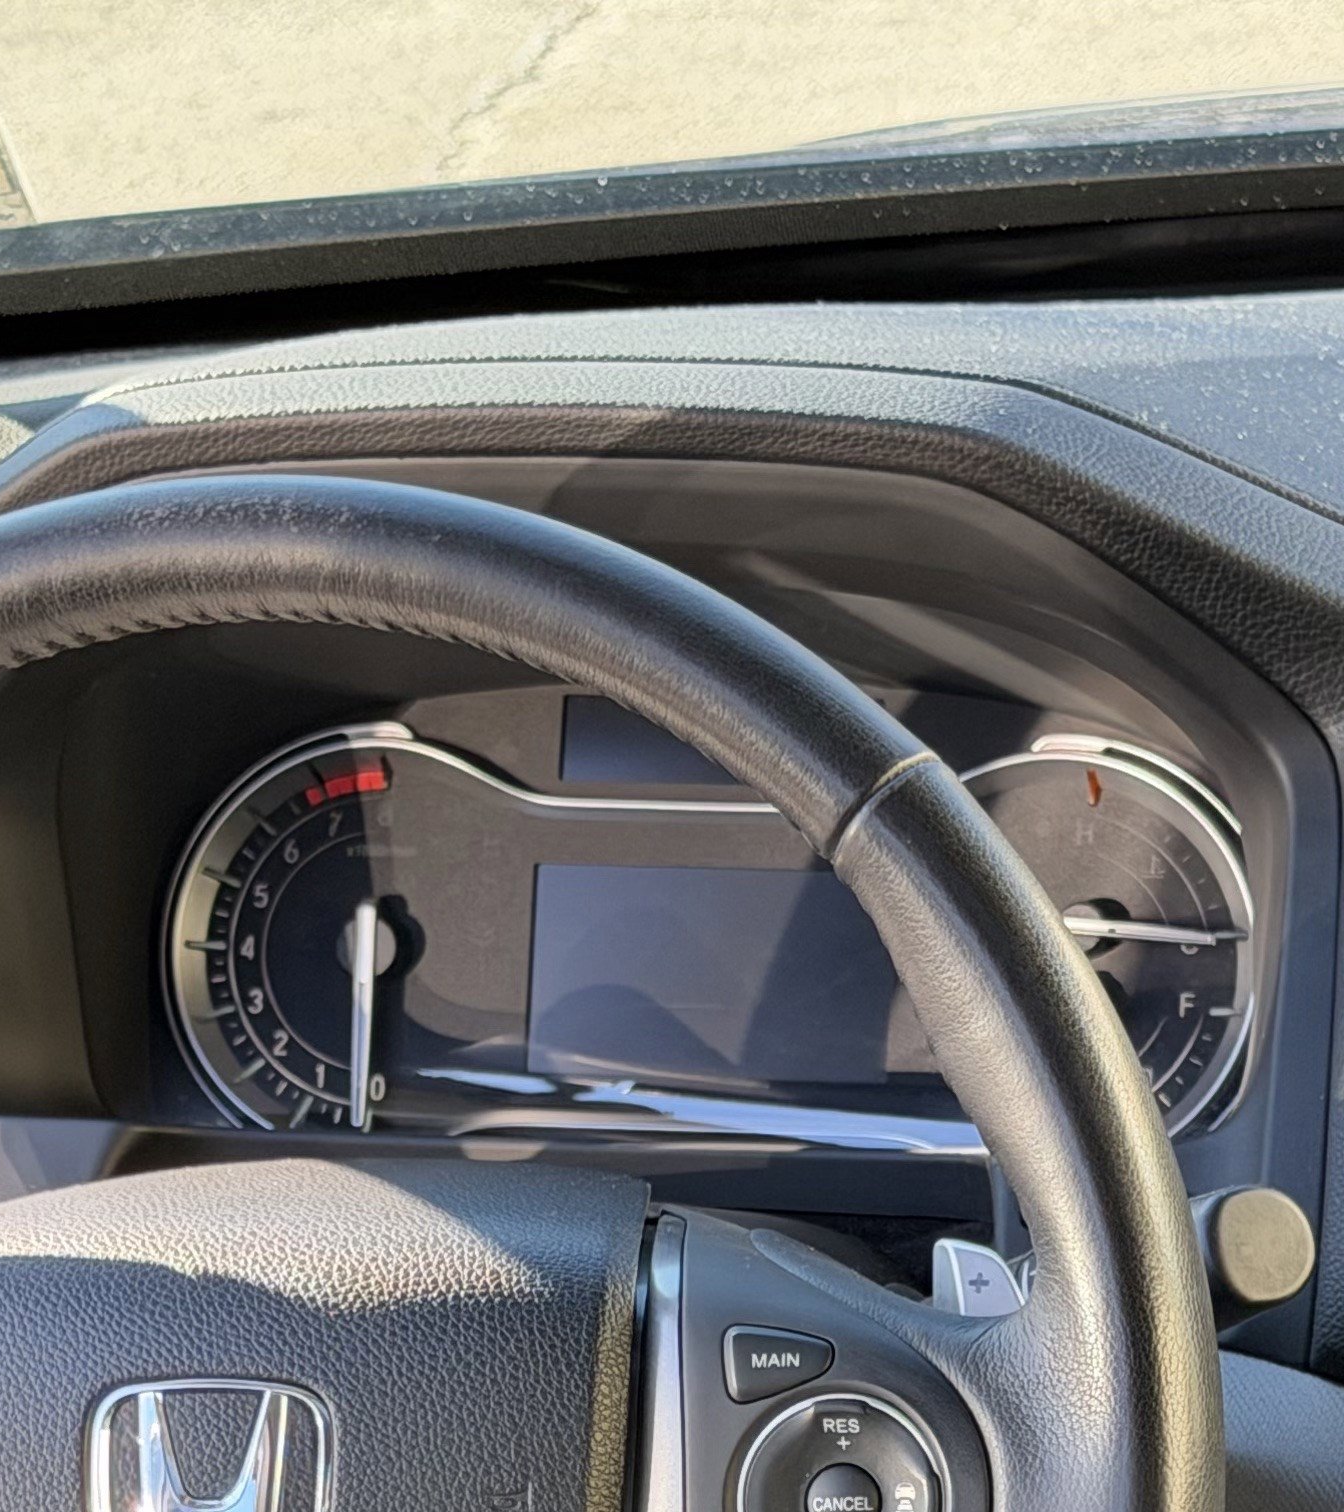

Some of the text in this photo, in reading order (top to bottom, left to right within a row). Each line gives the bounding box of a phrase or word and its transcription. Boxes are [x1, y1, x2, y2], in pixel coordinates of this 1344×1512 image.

[284, 841, 300, 865] 6
[251, 884, 269, 908] 5
[240, 937, 255, 962] 4
[248, 990, 264, 1015] 3
[1179, 992, 1195, 1017] F
[273, 1033, 287, 1057] 2
[316, 1065, 325, 1088] 1
[371, 1077, 386, 1102] 0
[751, 1351, 801, 1369] MAIN
[822, 1417, 861, 1435] RES
[812, 1495, 874, 1512] CANCEL
